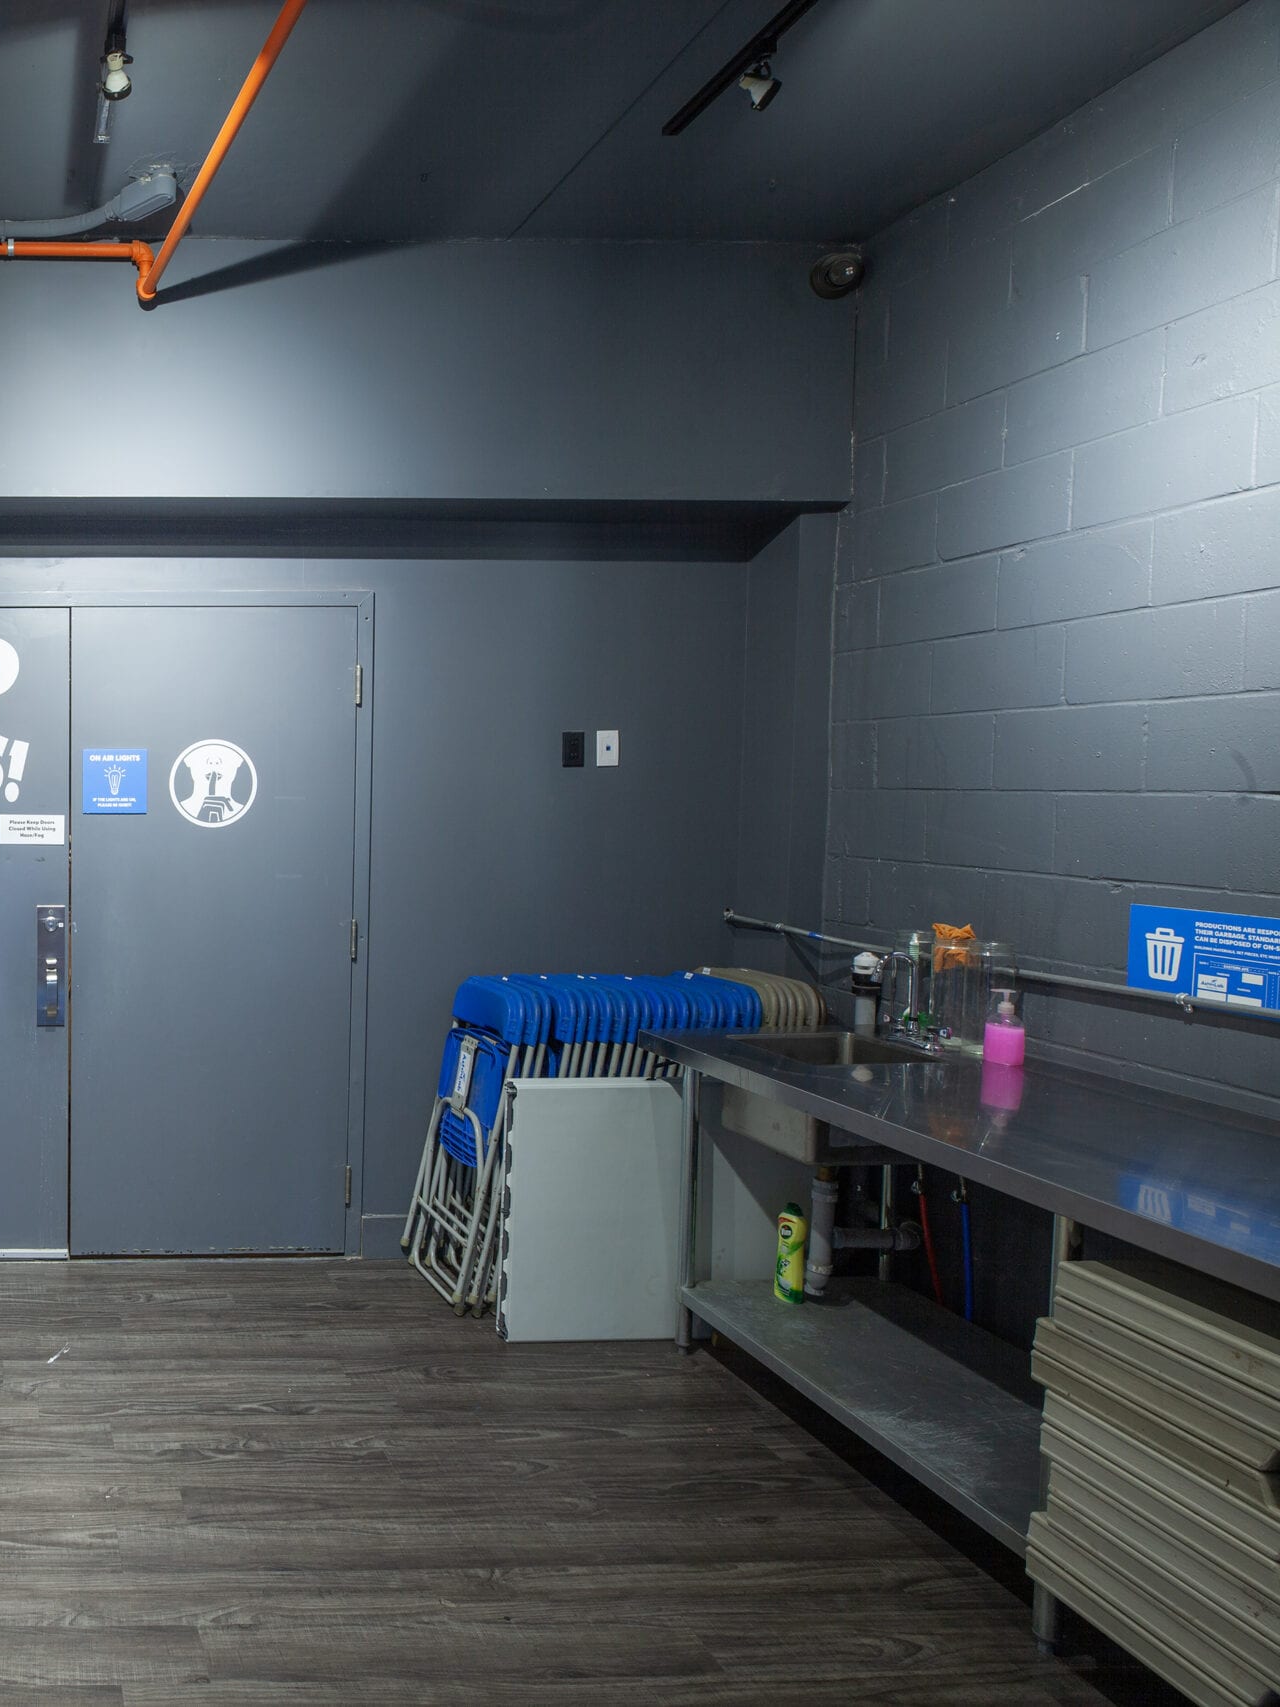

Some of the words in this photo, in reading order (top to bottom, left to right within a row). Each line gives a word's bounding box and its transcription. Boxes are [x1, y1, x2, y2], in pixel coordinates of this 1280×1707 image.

[89, 754, 101, 762] ON
[101, 754, 115, 762] AIR
[115, 754, 141, 762] LIGHTS
[1194, 921, 1242, 932] PRODUCTIONS
[1257, 928, 1280, 937] RESPO
[1194, 928, 1214, 936] THEIR
[1214, 930, 1247, 940] GARBAGE.
[1194, 935, 1209, 943] CAN
[1218, 938, 1251, 948] DISPOSED
